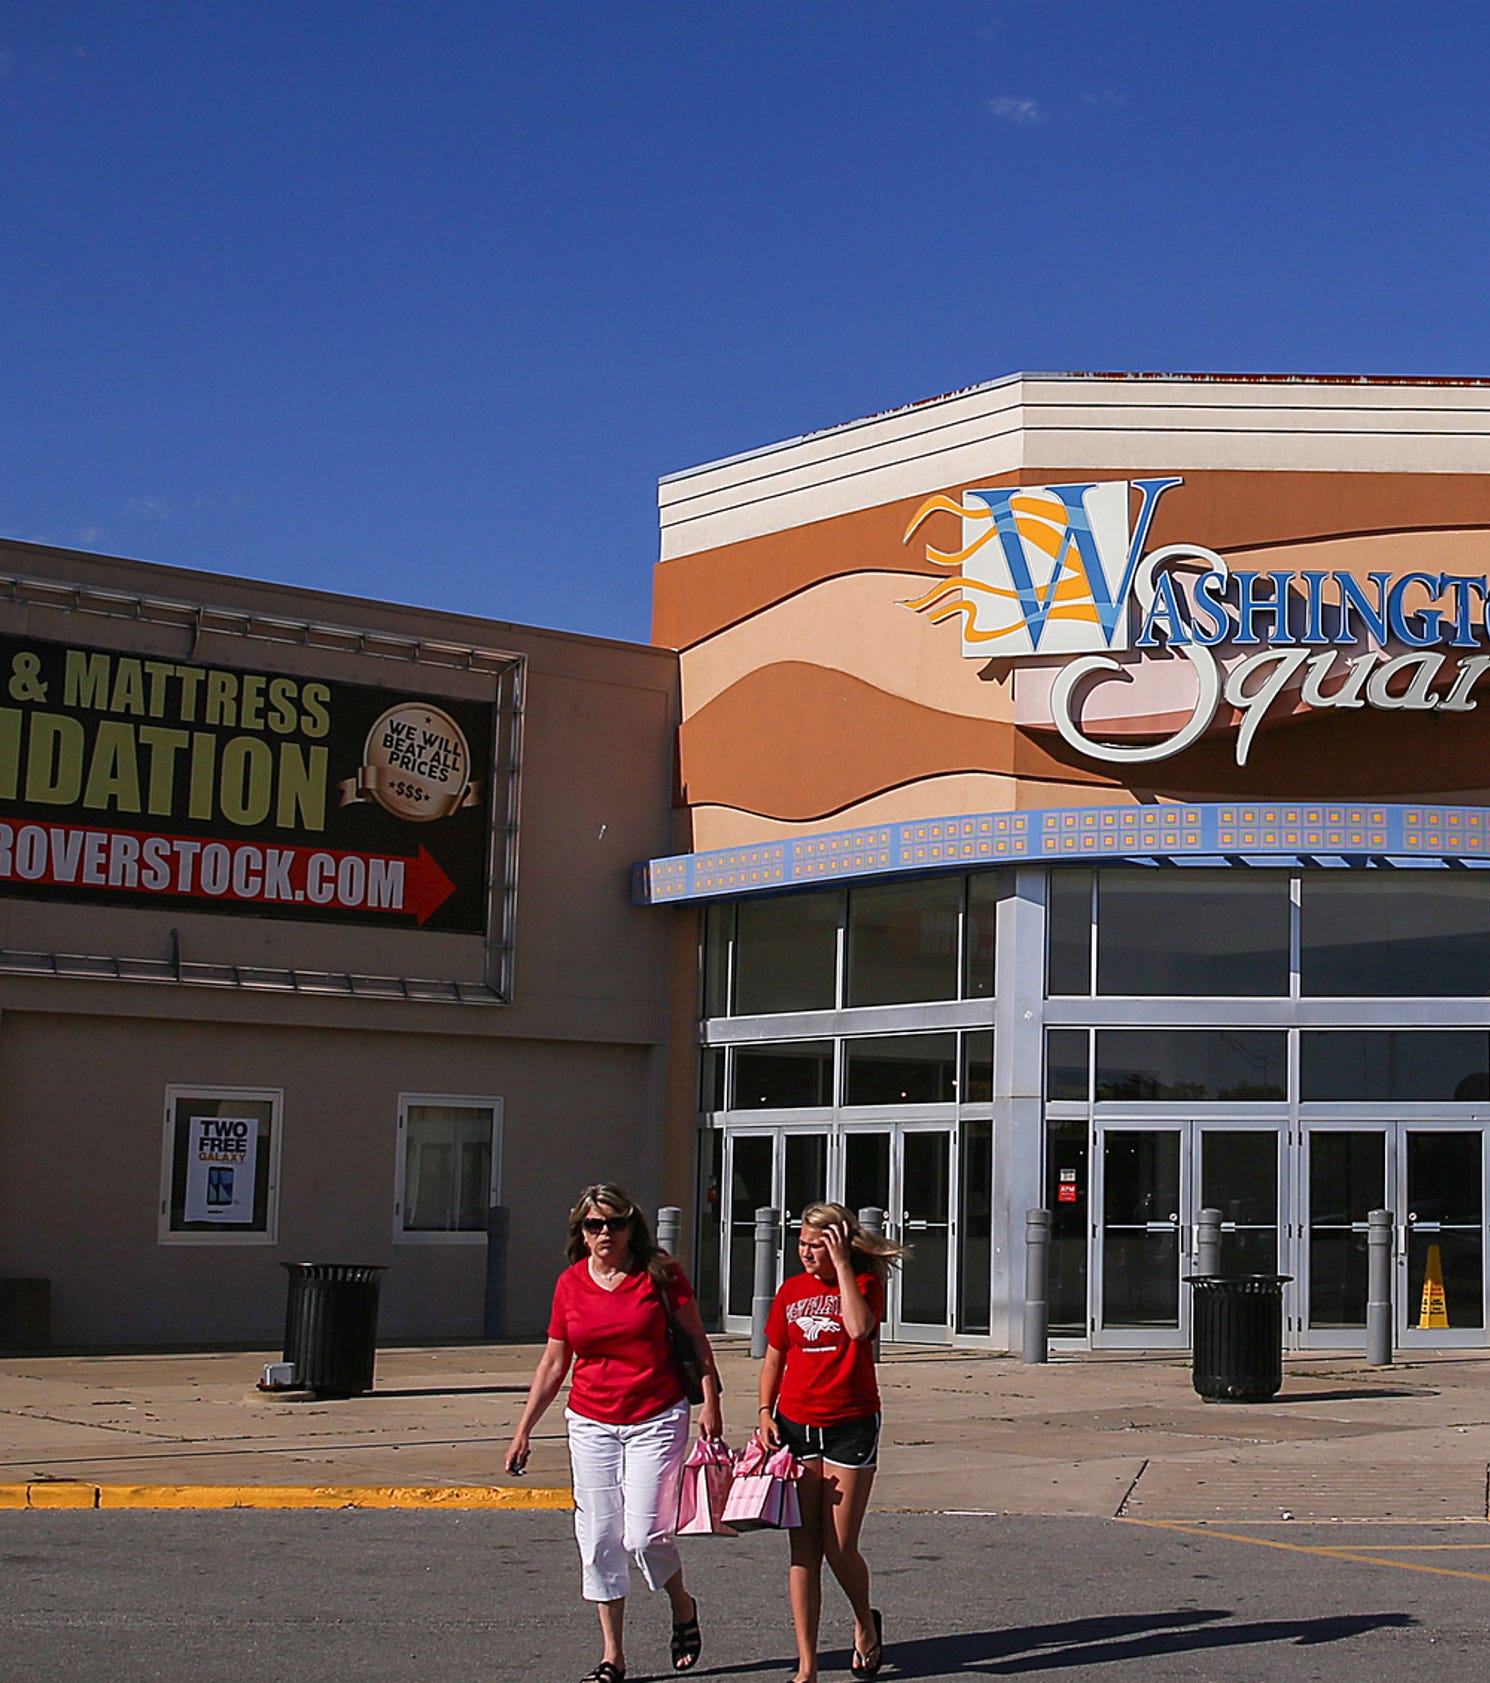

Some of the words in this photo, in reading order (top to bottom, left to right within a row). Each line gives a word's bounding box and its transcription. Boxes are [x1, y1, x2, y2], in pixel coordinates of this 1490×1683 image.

[8, 652, 48, 703] &
[63, 650, 331, 738] MATTRESS
[383, 733, 428, 759] BEAT
[429, 751, 460, 772] ALL
[389, 719, 417, 741] WE
[422, 731, 461, 757] WILL
[388, 752, 449, 782] PRICES
[200, 1121, 248, 1137] TWO
[198, 1152, 247, 1162] GALAXY
[199, 1138, 247, 1152] FREE
